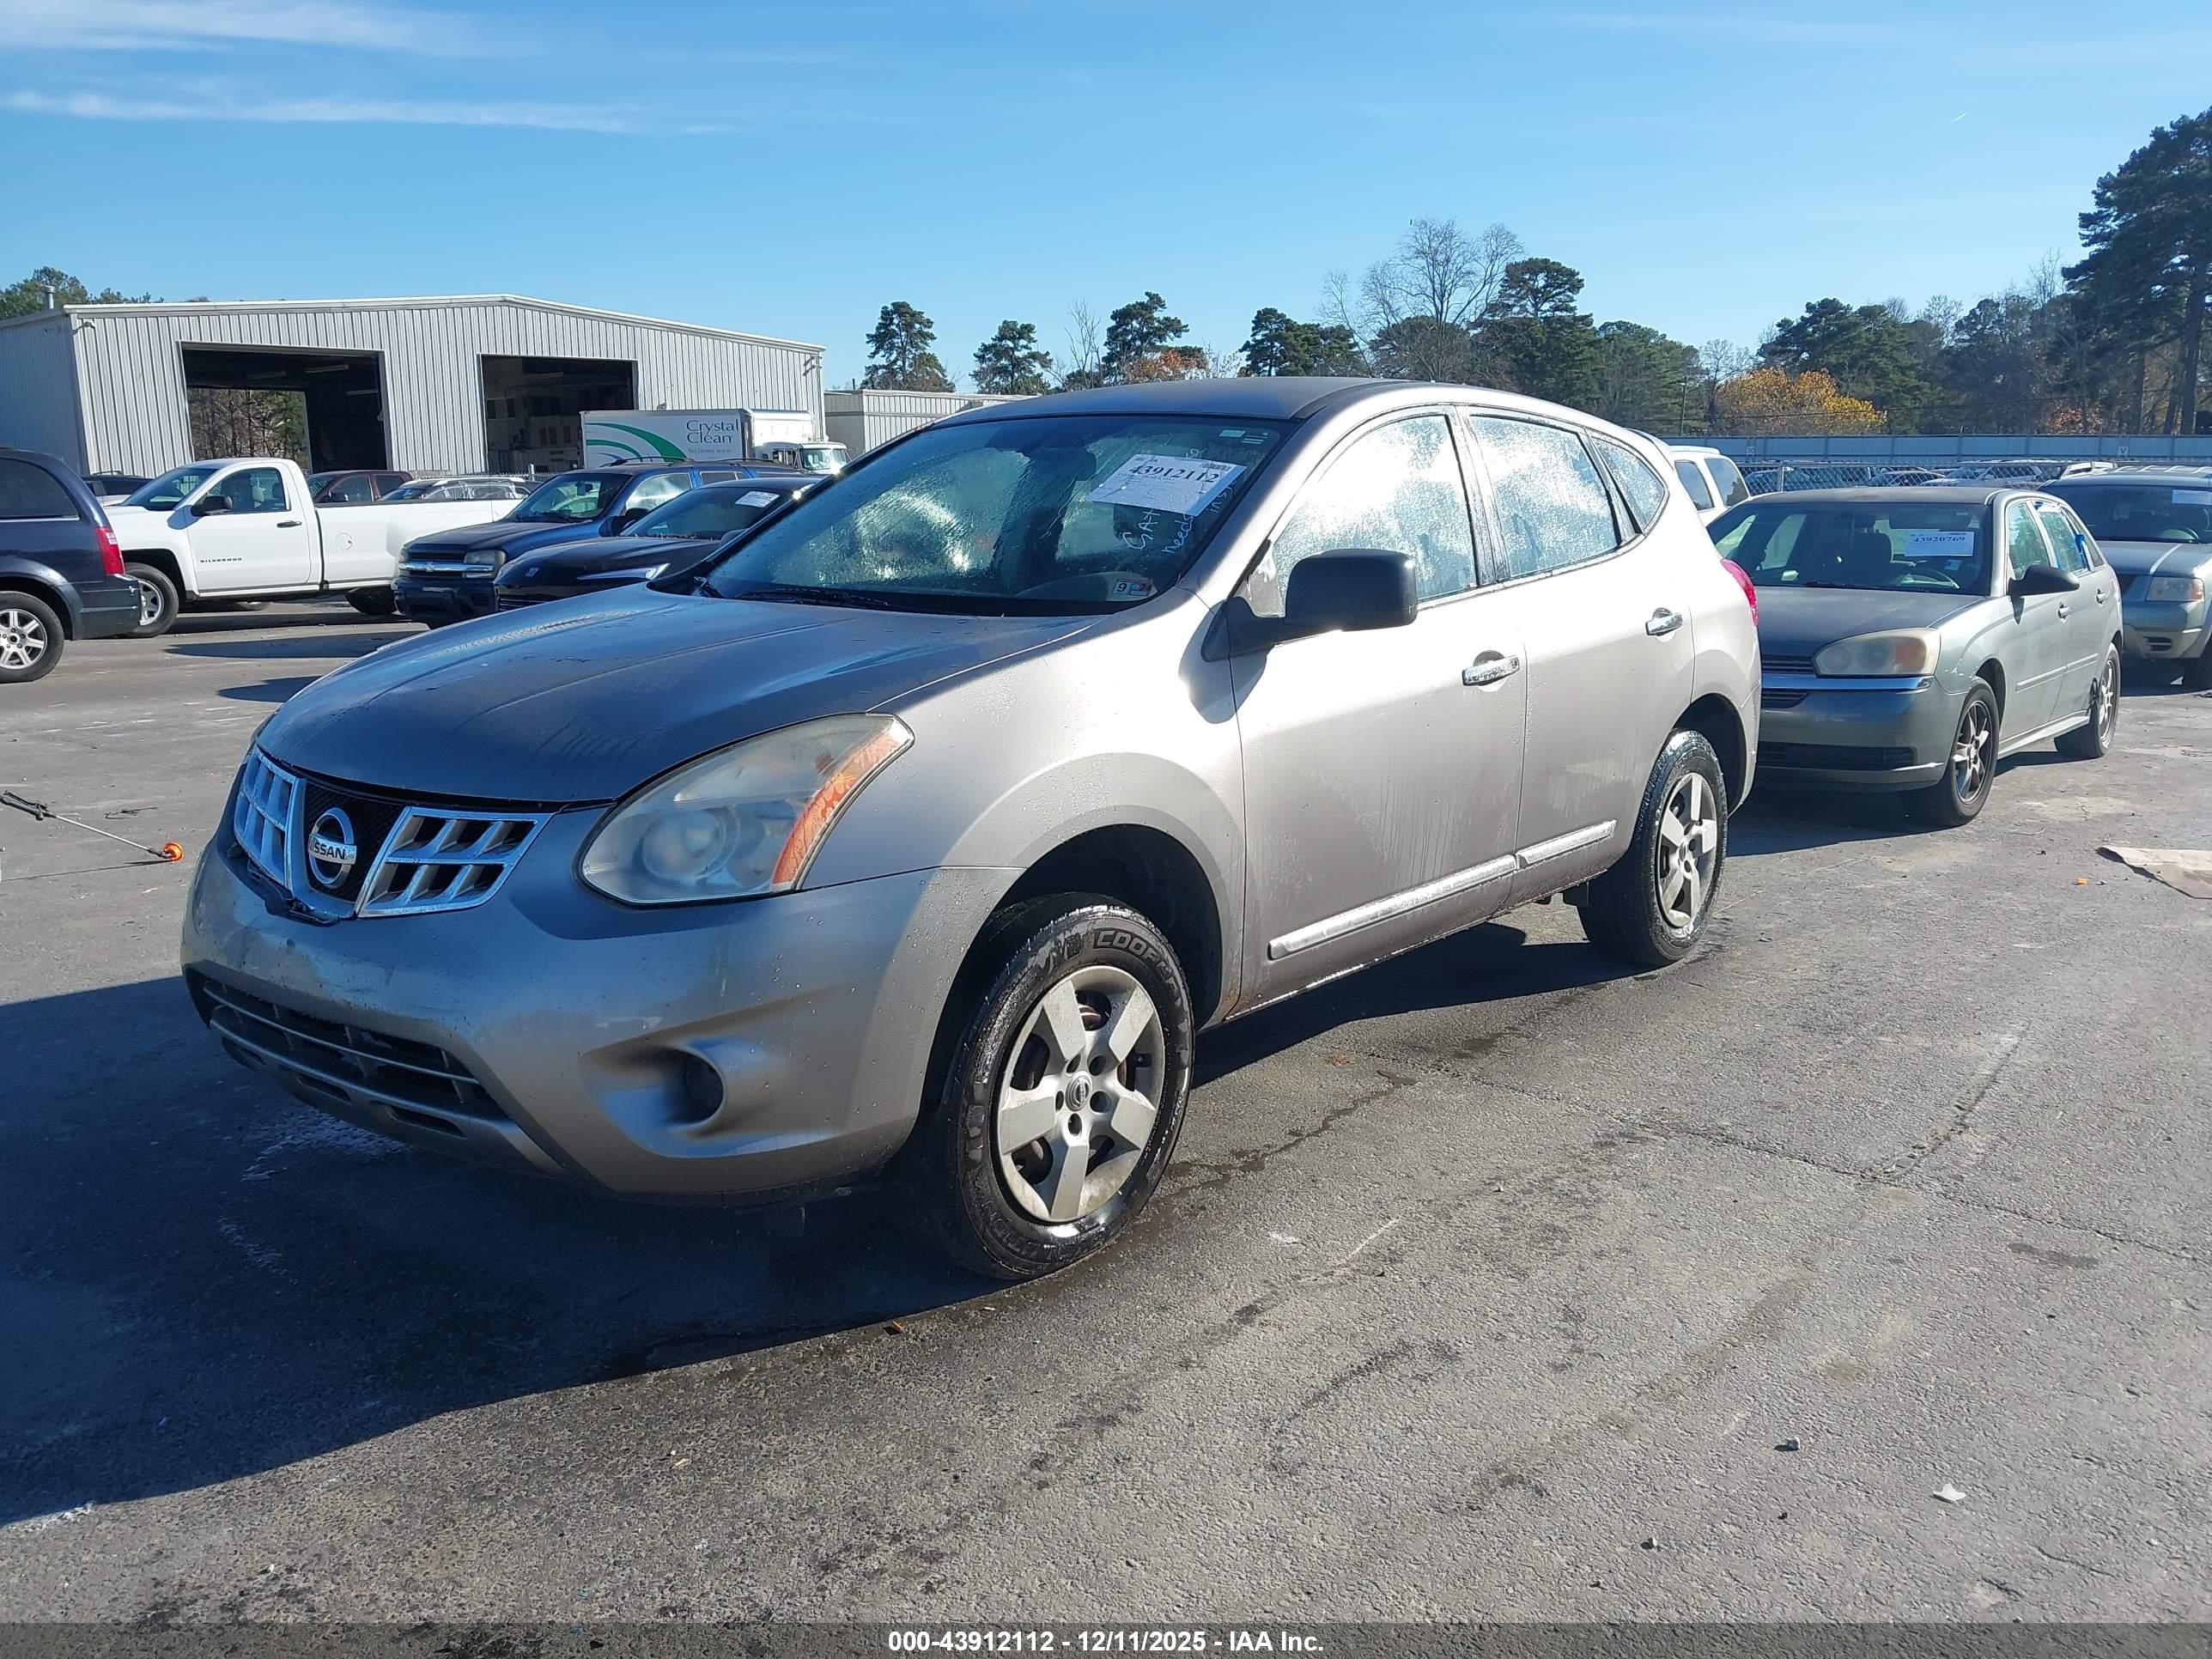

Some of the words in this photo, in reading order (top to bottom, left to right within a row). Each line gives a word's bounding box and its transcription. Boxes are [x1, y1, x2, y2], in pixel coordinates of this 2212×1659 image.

[687, 419, 738, 434] Crystal
[687, 432, 732, 443] Clean
[1129, 465, 1219, 483] 43912112
[1116, 583, 1127, 592] 9
[309, 836, 346, 860] NISSAN
